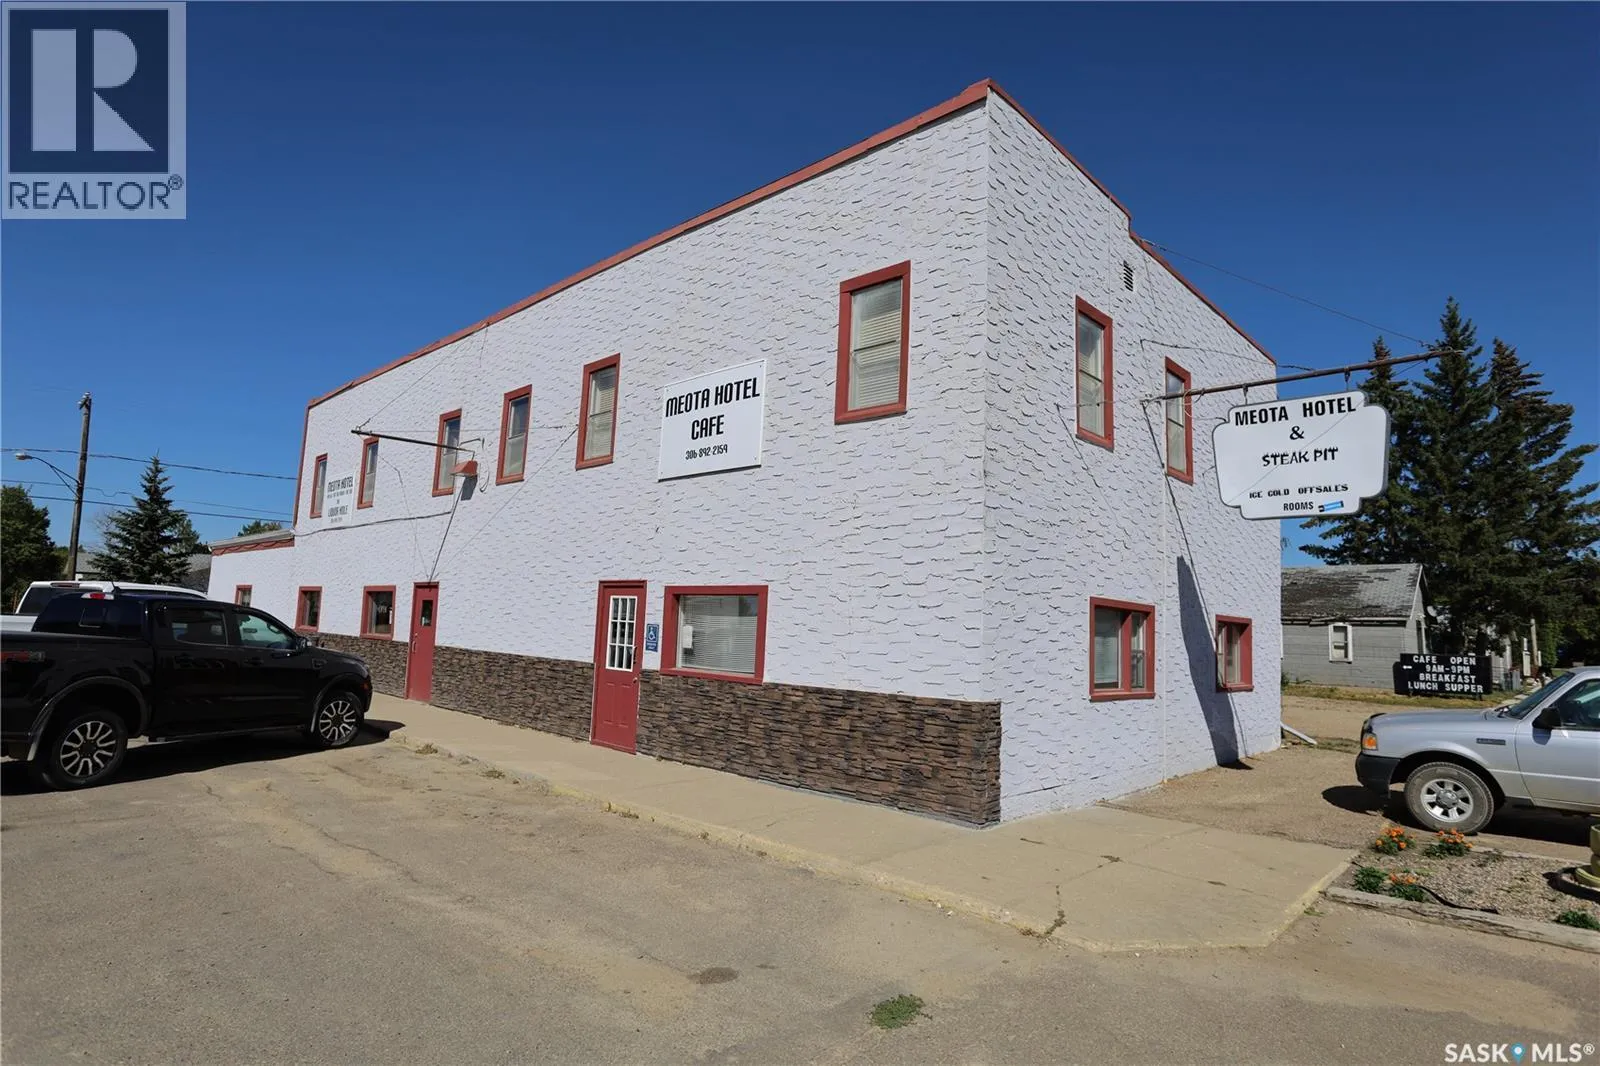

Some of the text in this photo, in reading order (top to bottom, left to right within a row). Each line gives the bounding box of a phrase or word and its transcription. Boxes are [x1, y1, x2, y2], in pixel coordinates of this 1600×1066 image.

[665, 377, 760, 417] MEOTA HOTEL
[1235, 397, 1356, 426] MEOTA HOTEL
[691, 414, 725, 440] CAFE
[1289, 425, 1304, 440] &
[685, 444, 728, 460] 306 892 2159
[1262, 446, 1339, 467] STEAK PIT
[1249, 490, 1263, 499] ICE
[1267, 488, 1290, 497] COLD
[1283, 501, 1314, 511] ROOMS
[1413, 655, 1476, 665] CAFE OPEN
[1419, 673, 1476, 683] BREAKFAST
[1408, 681, 1483, 693] LUNCH SUPPER
